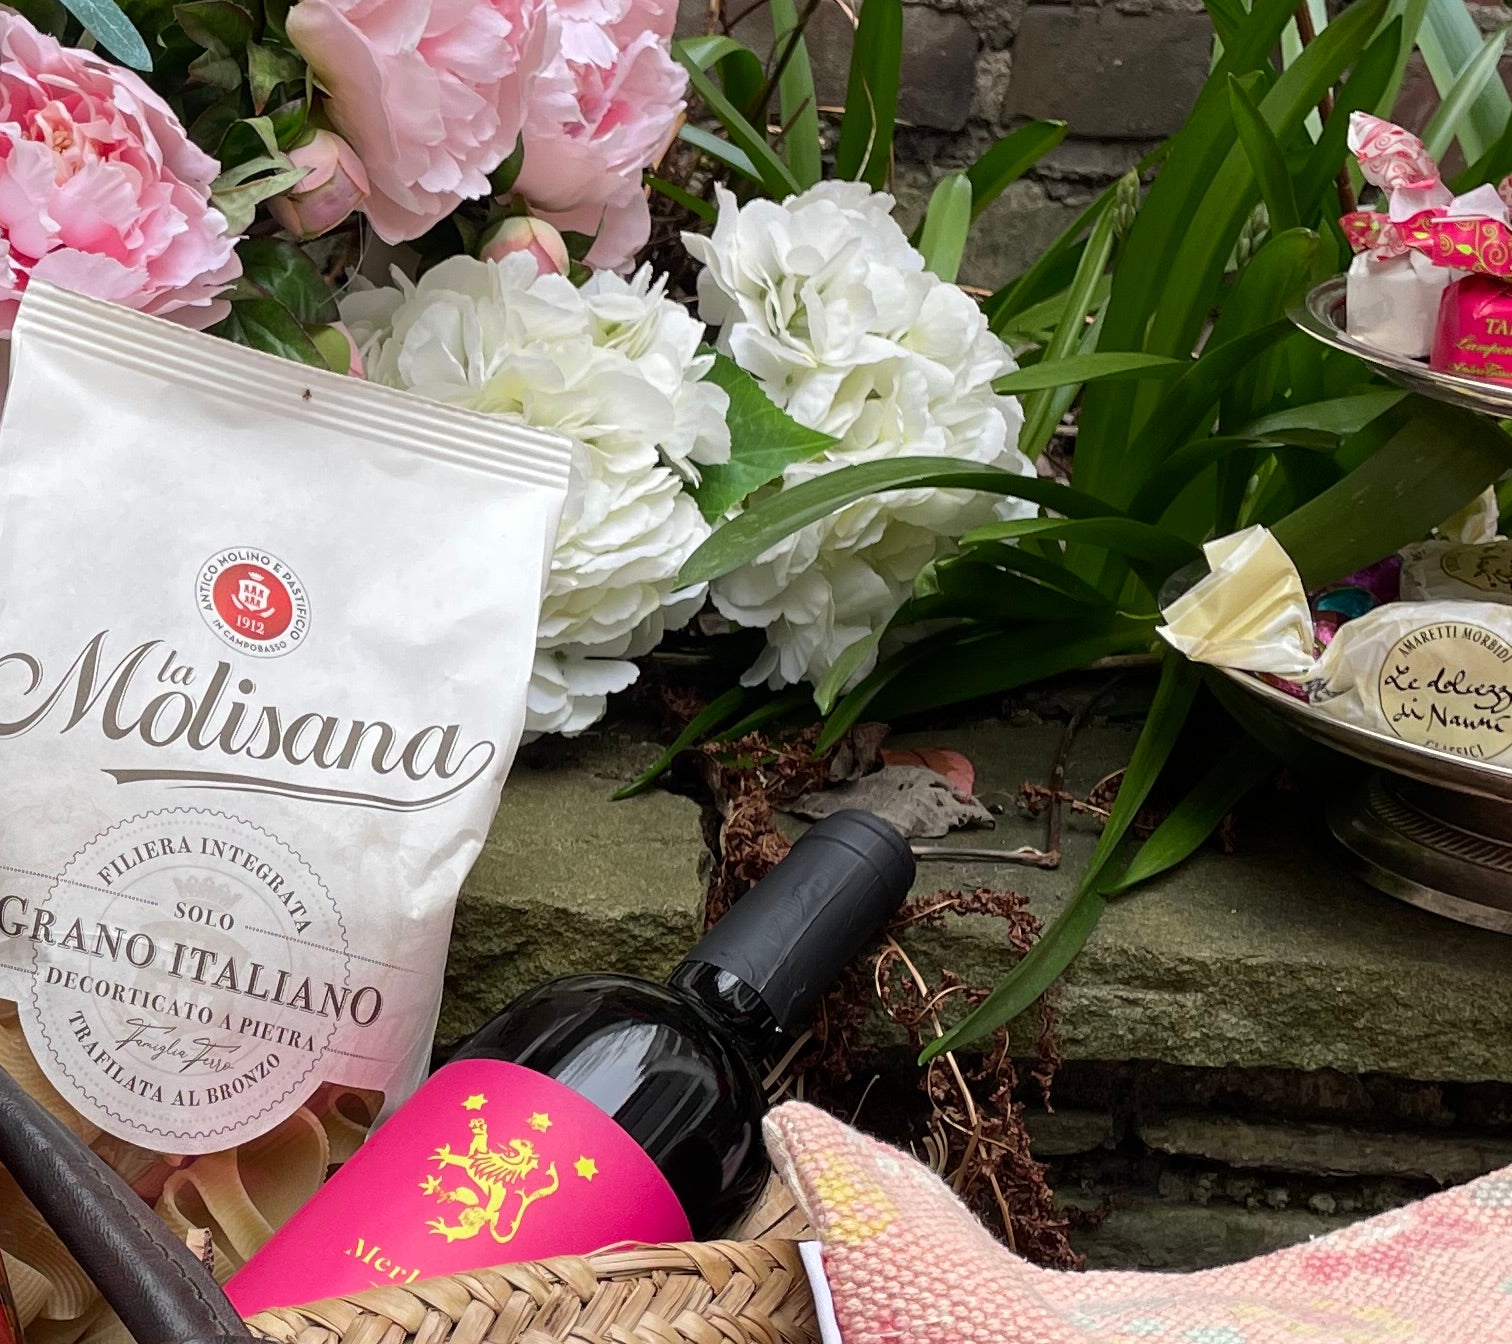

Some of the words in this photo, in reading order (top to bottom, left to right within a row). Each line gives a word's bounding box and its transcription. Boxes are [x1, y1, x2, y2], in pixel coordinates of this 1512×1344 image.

[200, 564, 218, 611] ANTICO
[218, 551, 271, 567] MOLINO
[273, 563, 283, 573] E
[282, 572, 307, 641] PASTIFICIO
[236, 615, 265, 635] 1912
[213, 619, 224, 630] IN
[223, 630, 287, 653] CAMPOBASSO
[1398, 625, 1457, 658] AMARETTI
[157, 650, 195, 686] la
[97, 835, 193, 886] FILIERA
[202, 837, 312, 935] INTEGRATA
[174, 901, 235, 931] SOLO
[45, 966, 214, 1026] DECORTICATO
[220, 1015, 234, 1032] A
[239, 1017, 316, 1052] PIETRA
[168, 943, 383, 1028] ITALIANO
[68, 1010, 164, 1105] TRAFILATA
[170, 1089, 201, 1107] AL
[206, 1052, 281, 1105] BRONZO
